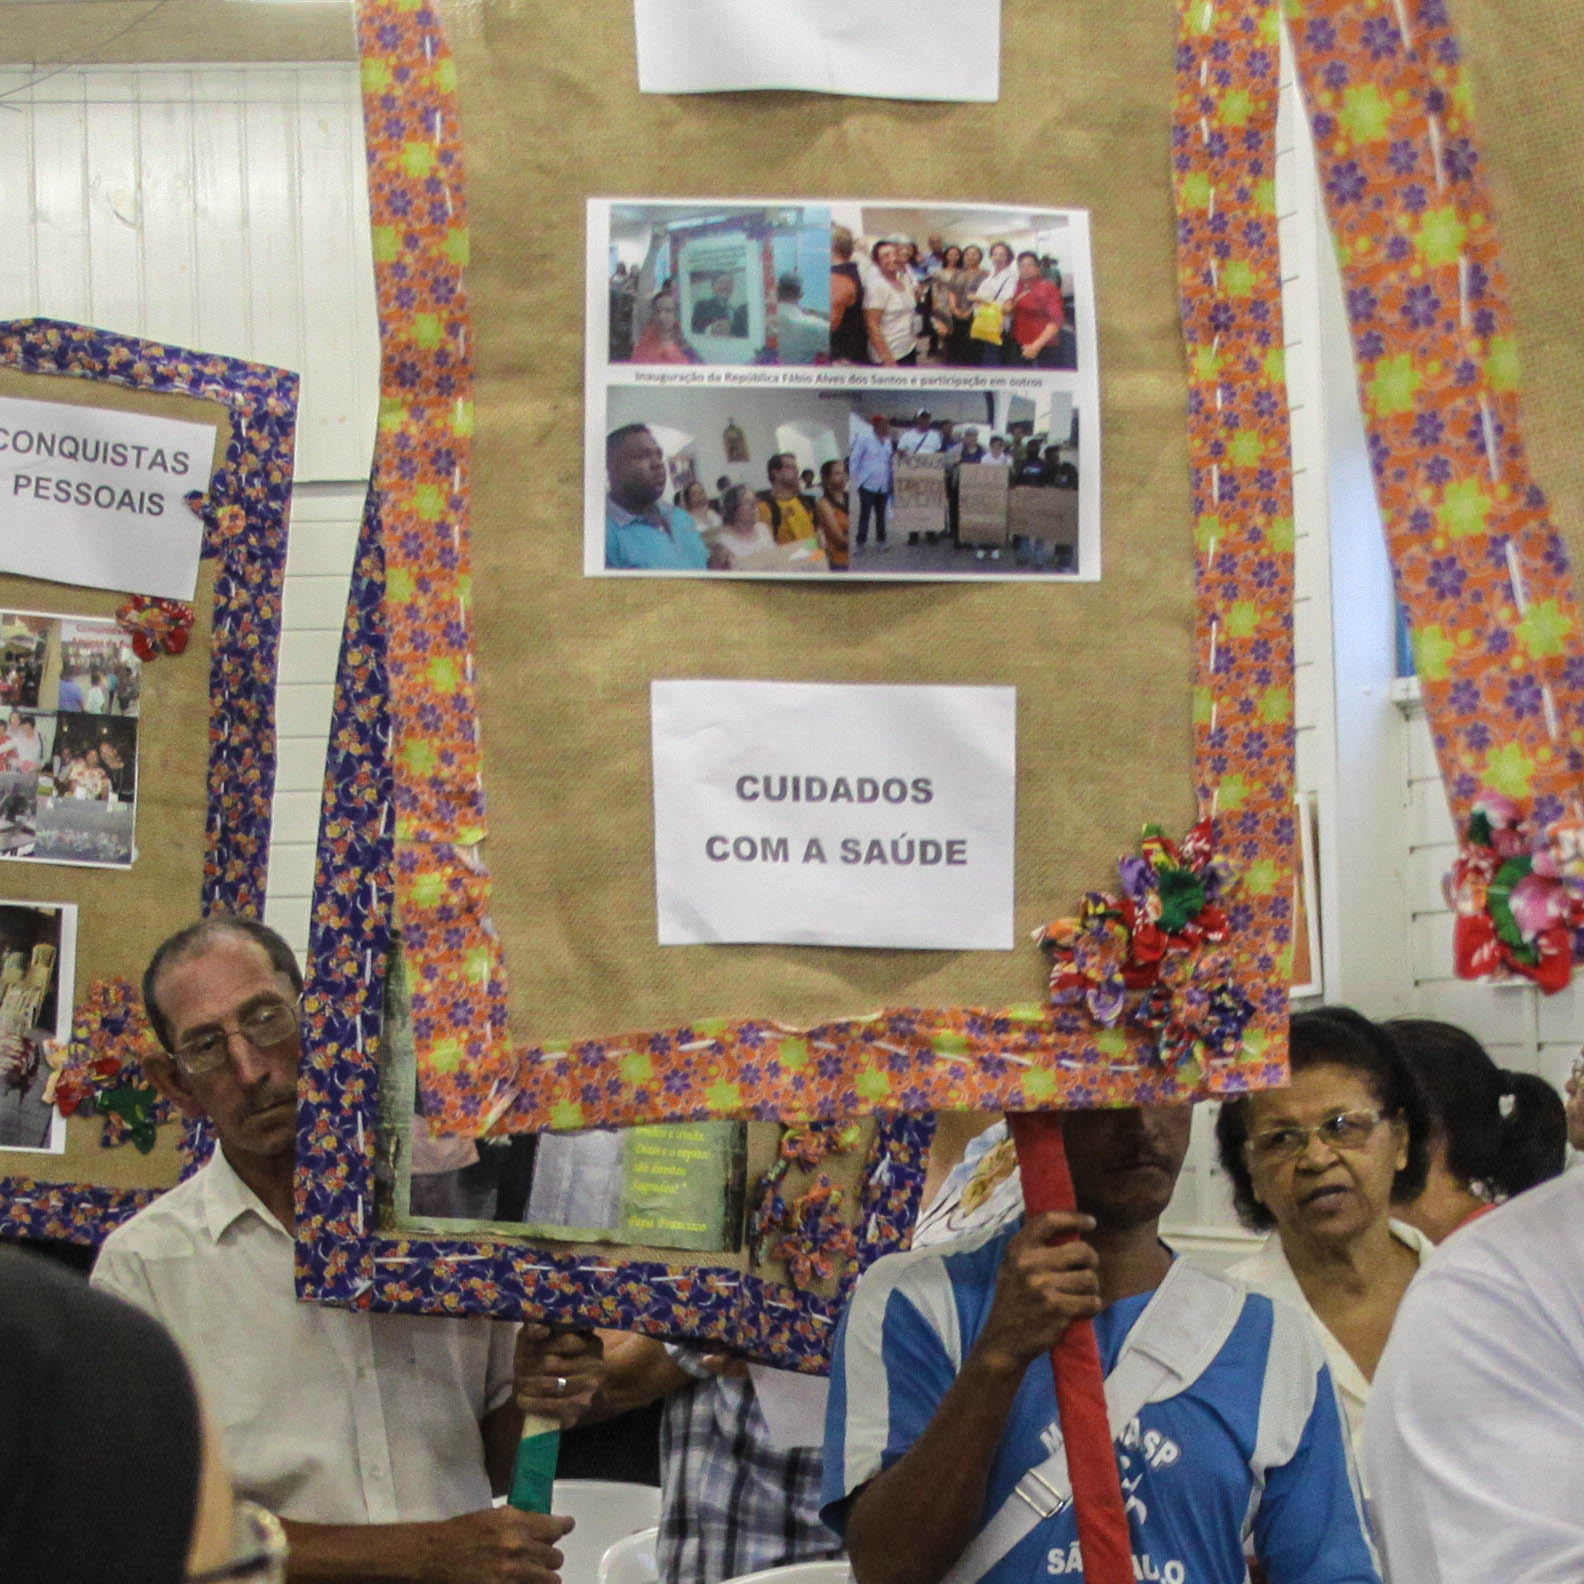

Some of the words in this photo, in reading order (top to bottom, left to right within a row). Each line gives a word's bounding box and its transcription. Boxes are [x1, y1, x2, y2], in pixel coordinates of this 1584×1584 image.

[634, 371, 705, 385] Inauguração
[724, 372, 779, 385] República
[816, 373, 845, 384] Alves
[871, 374, 907, 386] Santos
[920, 375, 987, 388] participação
[13, 474, 165, 516] PESSOAIS
[735, 775, 935, 805] CUIDADOS
[705, 835, 790, 865] COM
[802, 837, 828, 865] A
[840, 832, 968, 866] SAÚDE
